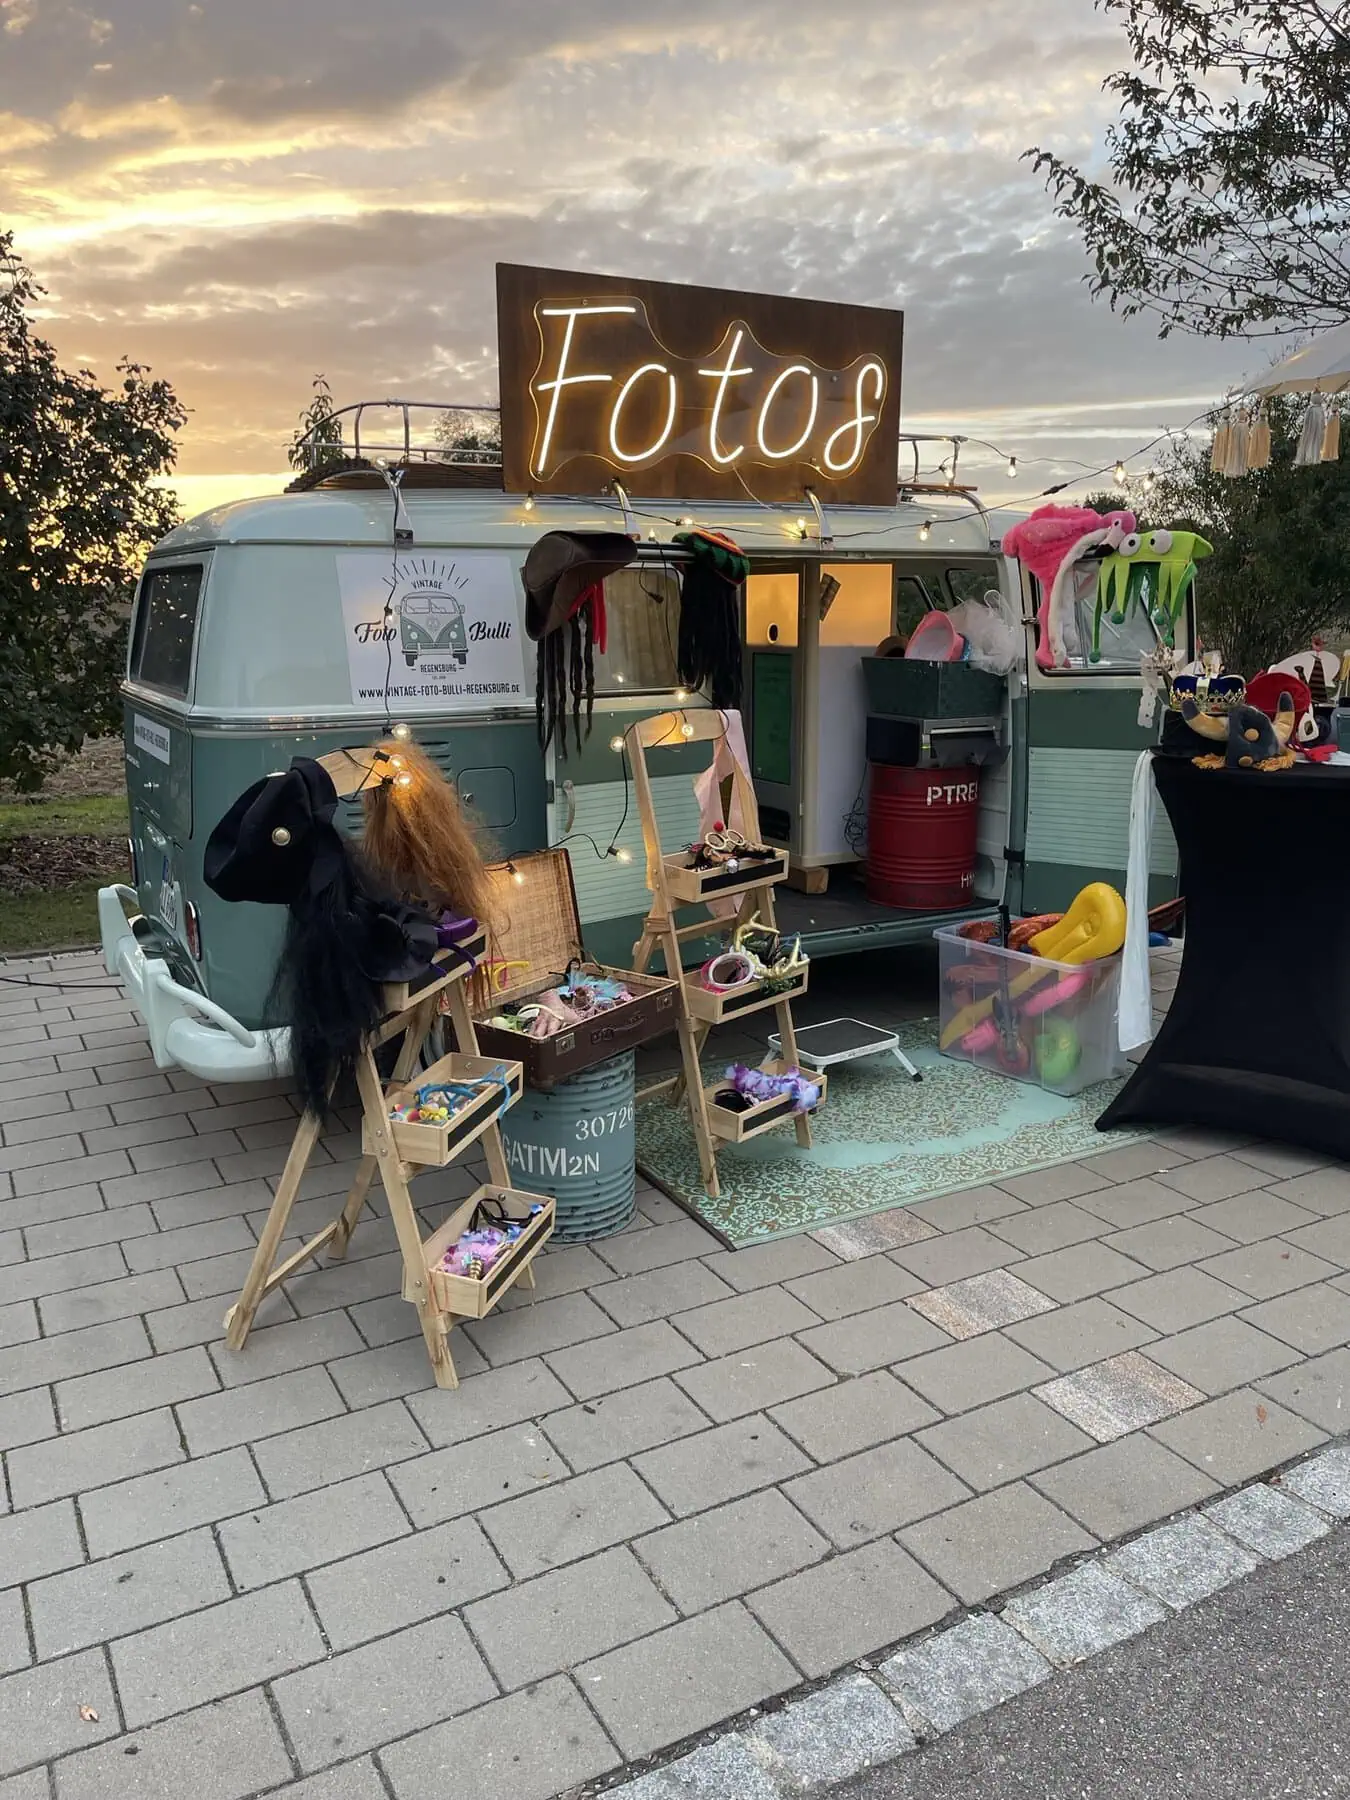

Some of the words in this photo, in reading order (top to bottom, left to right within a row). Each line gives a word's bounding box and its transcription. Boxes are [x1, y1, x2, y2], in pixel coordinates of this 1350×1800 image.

[537, 306, 883, 472] Fotos
[411, 580, 443, 590] VINTAGE
[354, 620, 397, 643] Foto
[469, 621, 511, 641] Bulli
[420, 664, 457, 673] REGENSBURG
